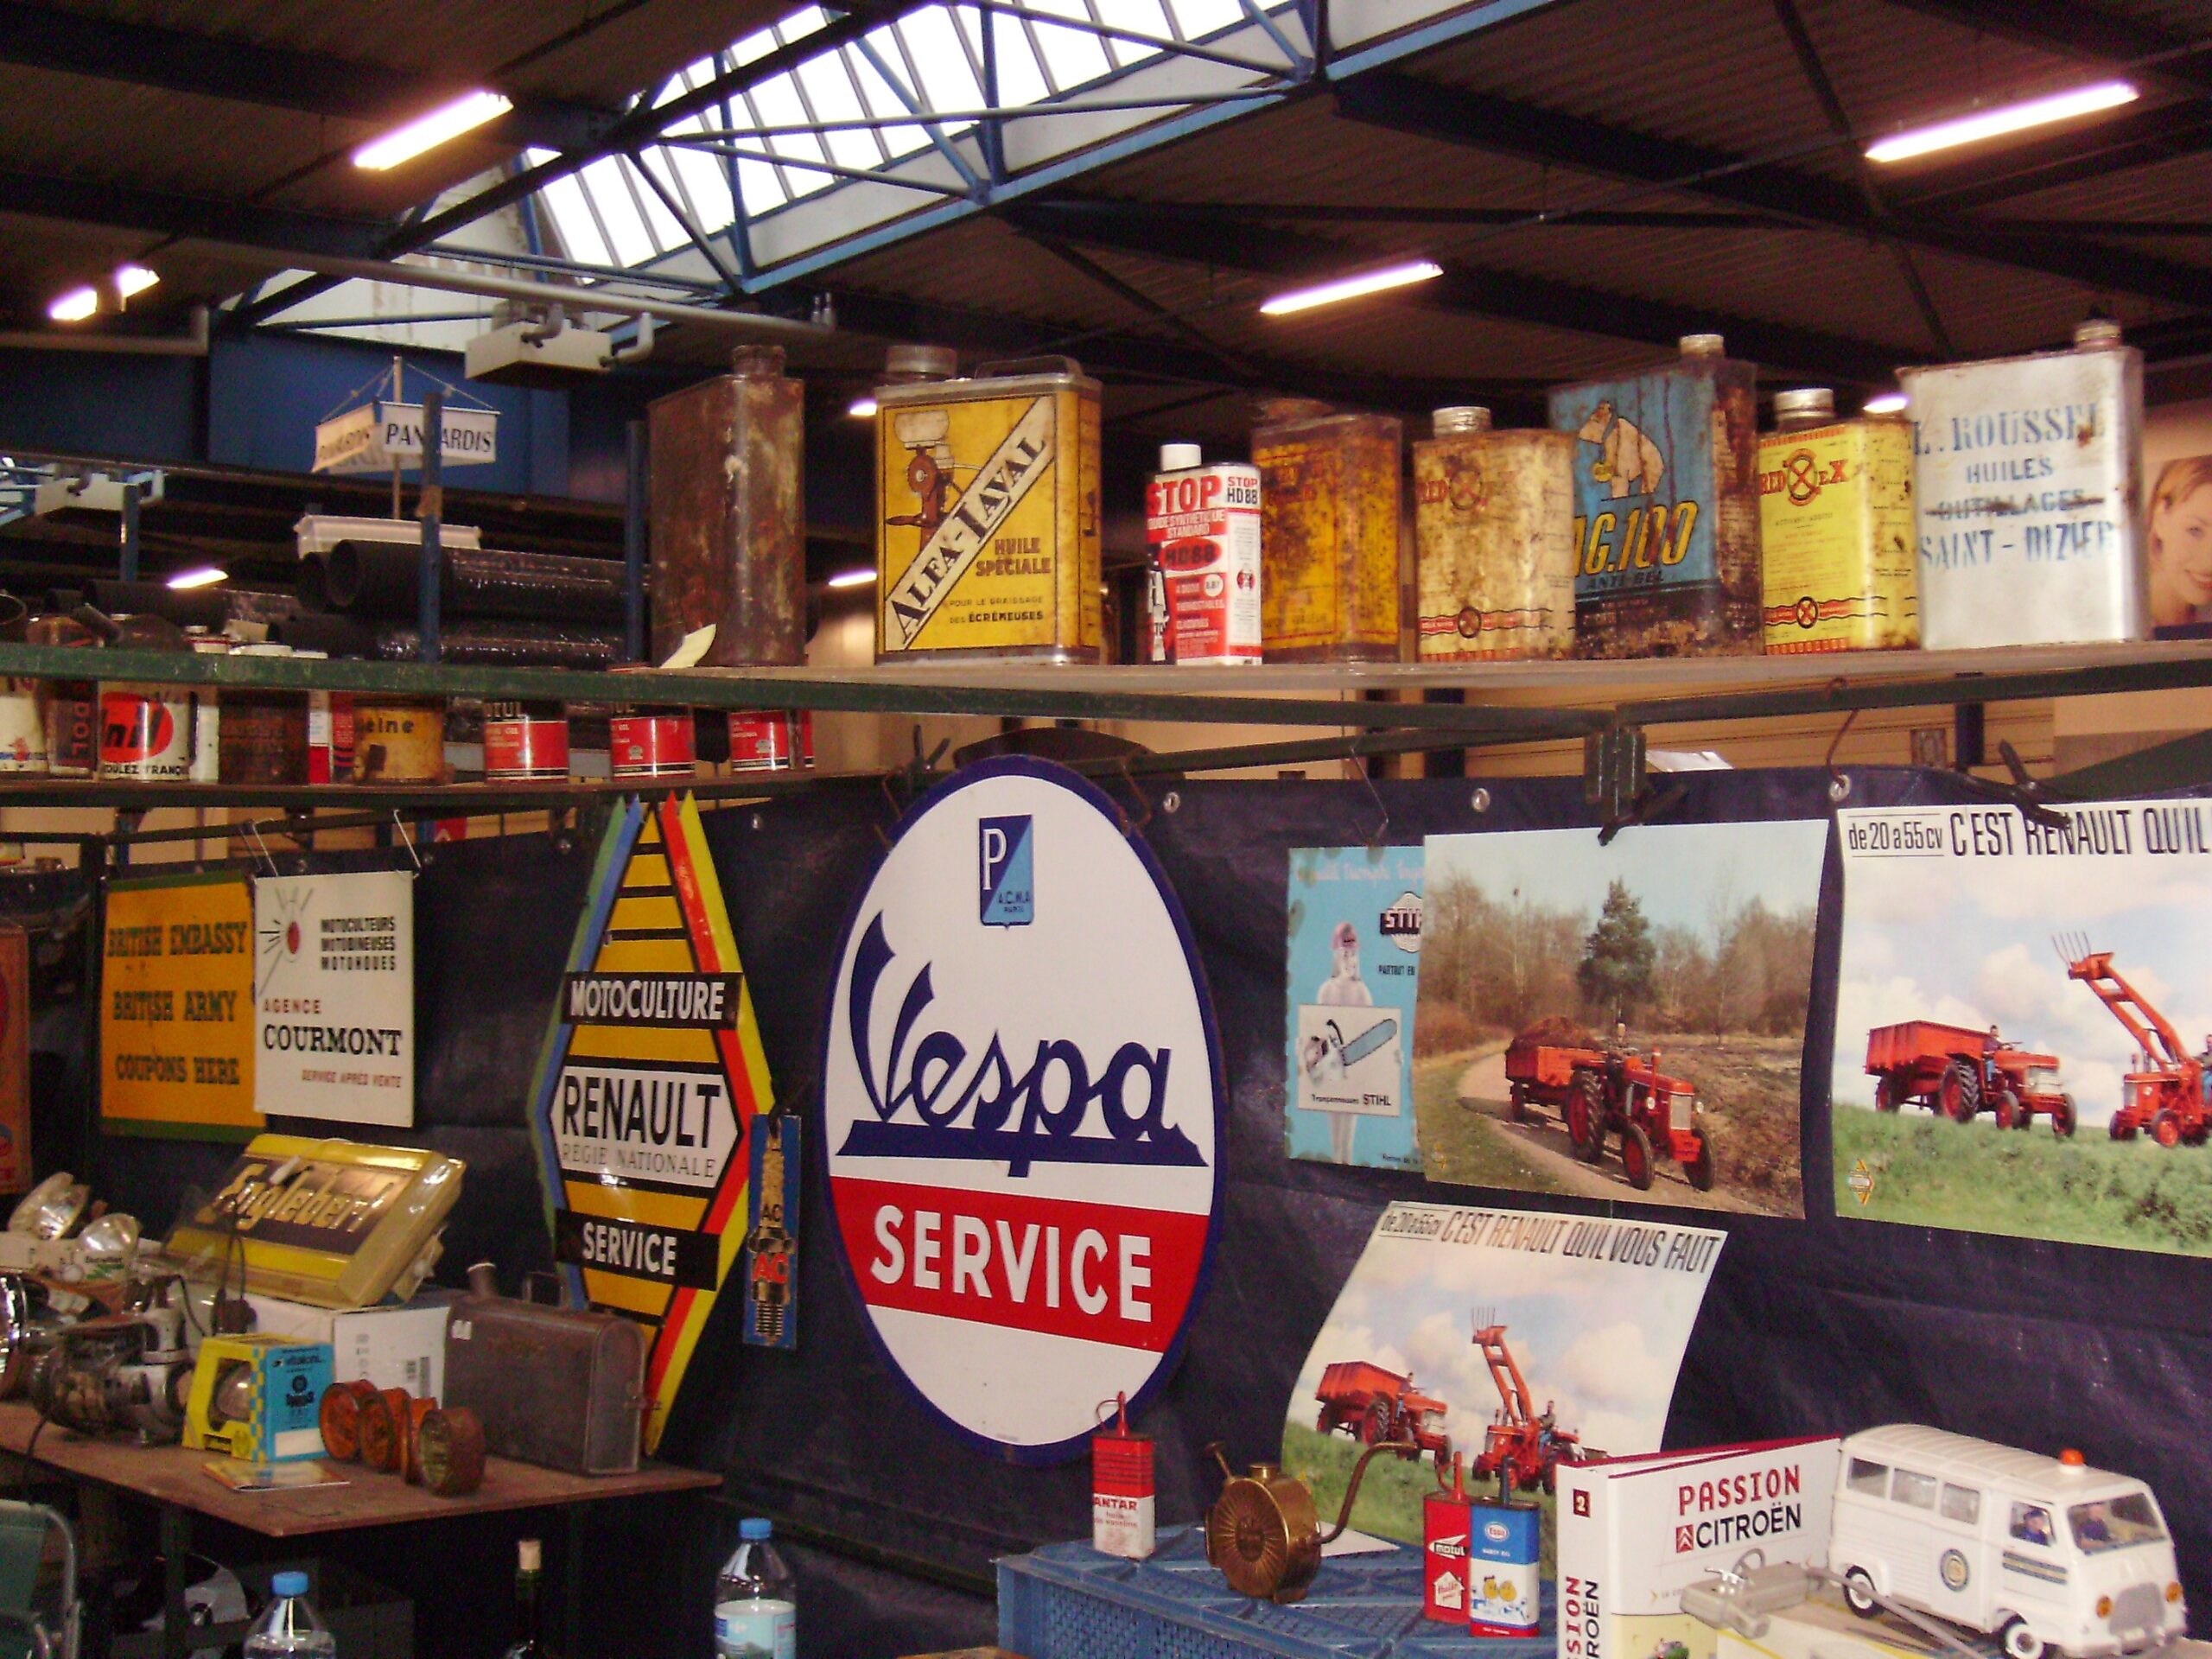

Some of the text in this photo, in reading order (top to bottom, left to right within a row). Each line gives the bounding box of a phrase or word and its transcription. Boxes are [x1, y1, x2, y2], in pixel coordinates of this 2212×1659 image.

[1951, 403, 2106, 452] ROUSSEL
[1227, 476, 1259, 487] STOP
[1966, 457, 2054, 484] HUILES
[1147, 474, 1223, 518] STOP
[890, 435, 1047, 646] ALFA-LAVAL
[995, 537, 1040, 556] HUILE
[1920, 530, 1994, 570] SAINT
[1848, 823, 1868, 850] de
[1869, 822, 1890, 850] 20
[1904, 821, 1924, 849] 55
[1926, 828, 1943, 849] cv
[2023, 809, 2133, 855] RENAULT
[982, 828, 1008, 890] P
[107, 920, 248, 958] BRITISH EMBASSY
[112, 989, 238, 1023] BRITISH ARMY
[263, 998, 322, 1014] AGENCE
[570, 979, 726, 1020] MOTOCULTURE
[264, 1023, 404, 1058] COURMONT
[849, 909, 1192, 1178] Vespa
[115, 1053, 240, 1086] COUPONS HERE
[562, 1074, 721, 1150] RENAULT
[1363, 1093, 1392, 1107] STIHL
[616, 1147, 717, 1179] NATIONALE
[762, 1203, 783, 1223] AC
[582, 1221, 677, 1277] SERVICE
[1485, 1215, 1568, 1255] RENAULT
[1609, 1225, 1666, 1267] VOUS
[1664, 1232, 1720, 1274] FAUT
[752, 1252, 789, 1285] AC
[869, 1203, 1154, 1325] SERVICE
[1092, 1497, 1138, 1511] ANTAR
[1576, 1496, 1586, 1512] 2
[1679, 1465, 1801, 1516] PASSION
[1489, 1527, 1506, 1537] Esso
[1695, 1501, 1802, 1549] CITROËN
